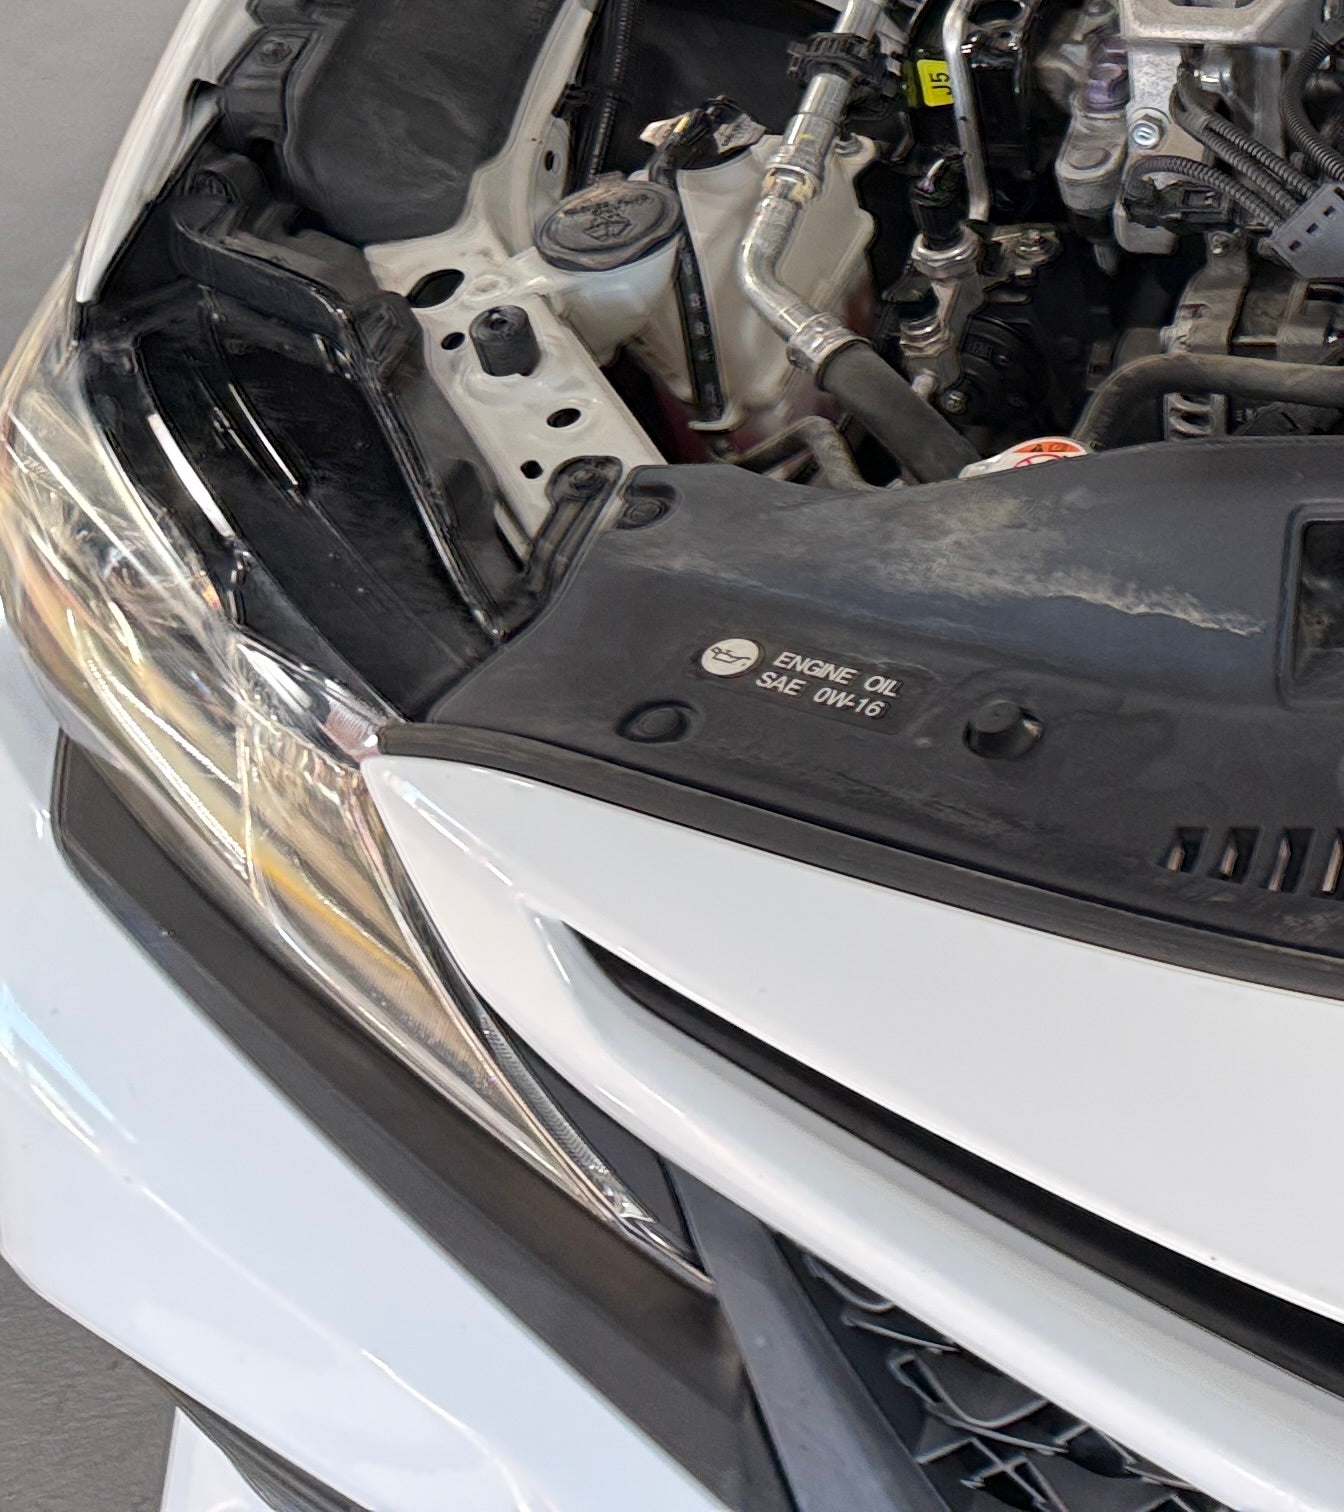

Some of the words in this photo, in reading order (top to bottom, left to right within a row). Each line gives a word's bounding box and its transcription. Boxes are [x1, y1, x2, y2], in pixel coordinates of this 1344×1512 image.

[928, 72, 952, 95] J5
[756, 672, 807, 696] SAE
[814, 687, 885, 717] 0W-16
[773, 651, 858, 685] ENGINE
[864, 675, 901, 697] OIL
